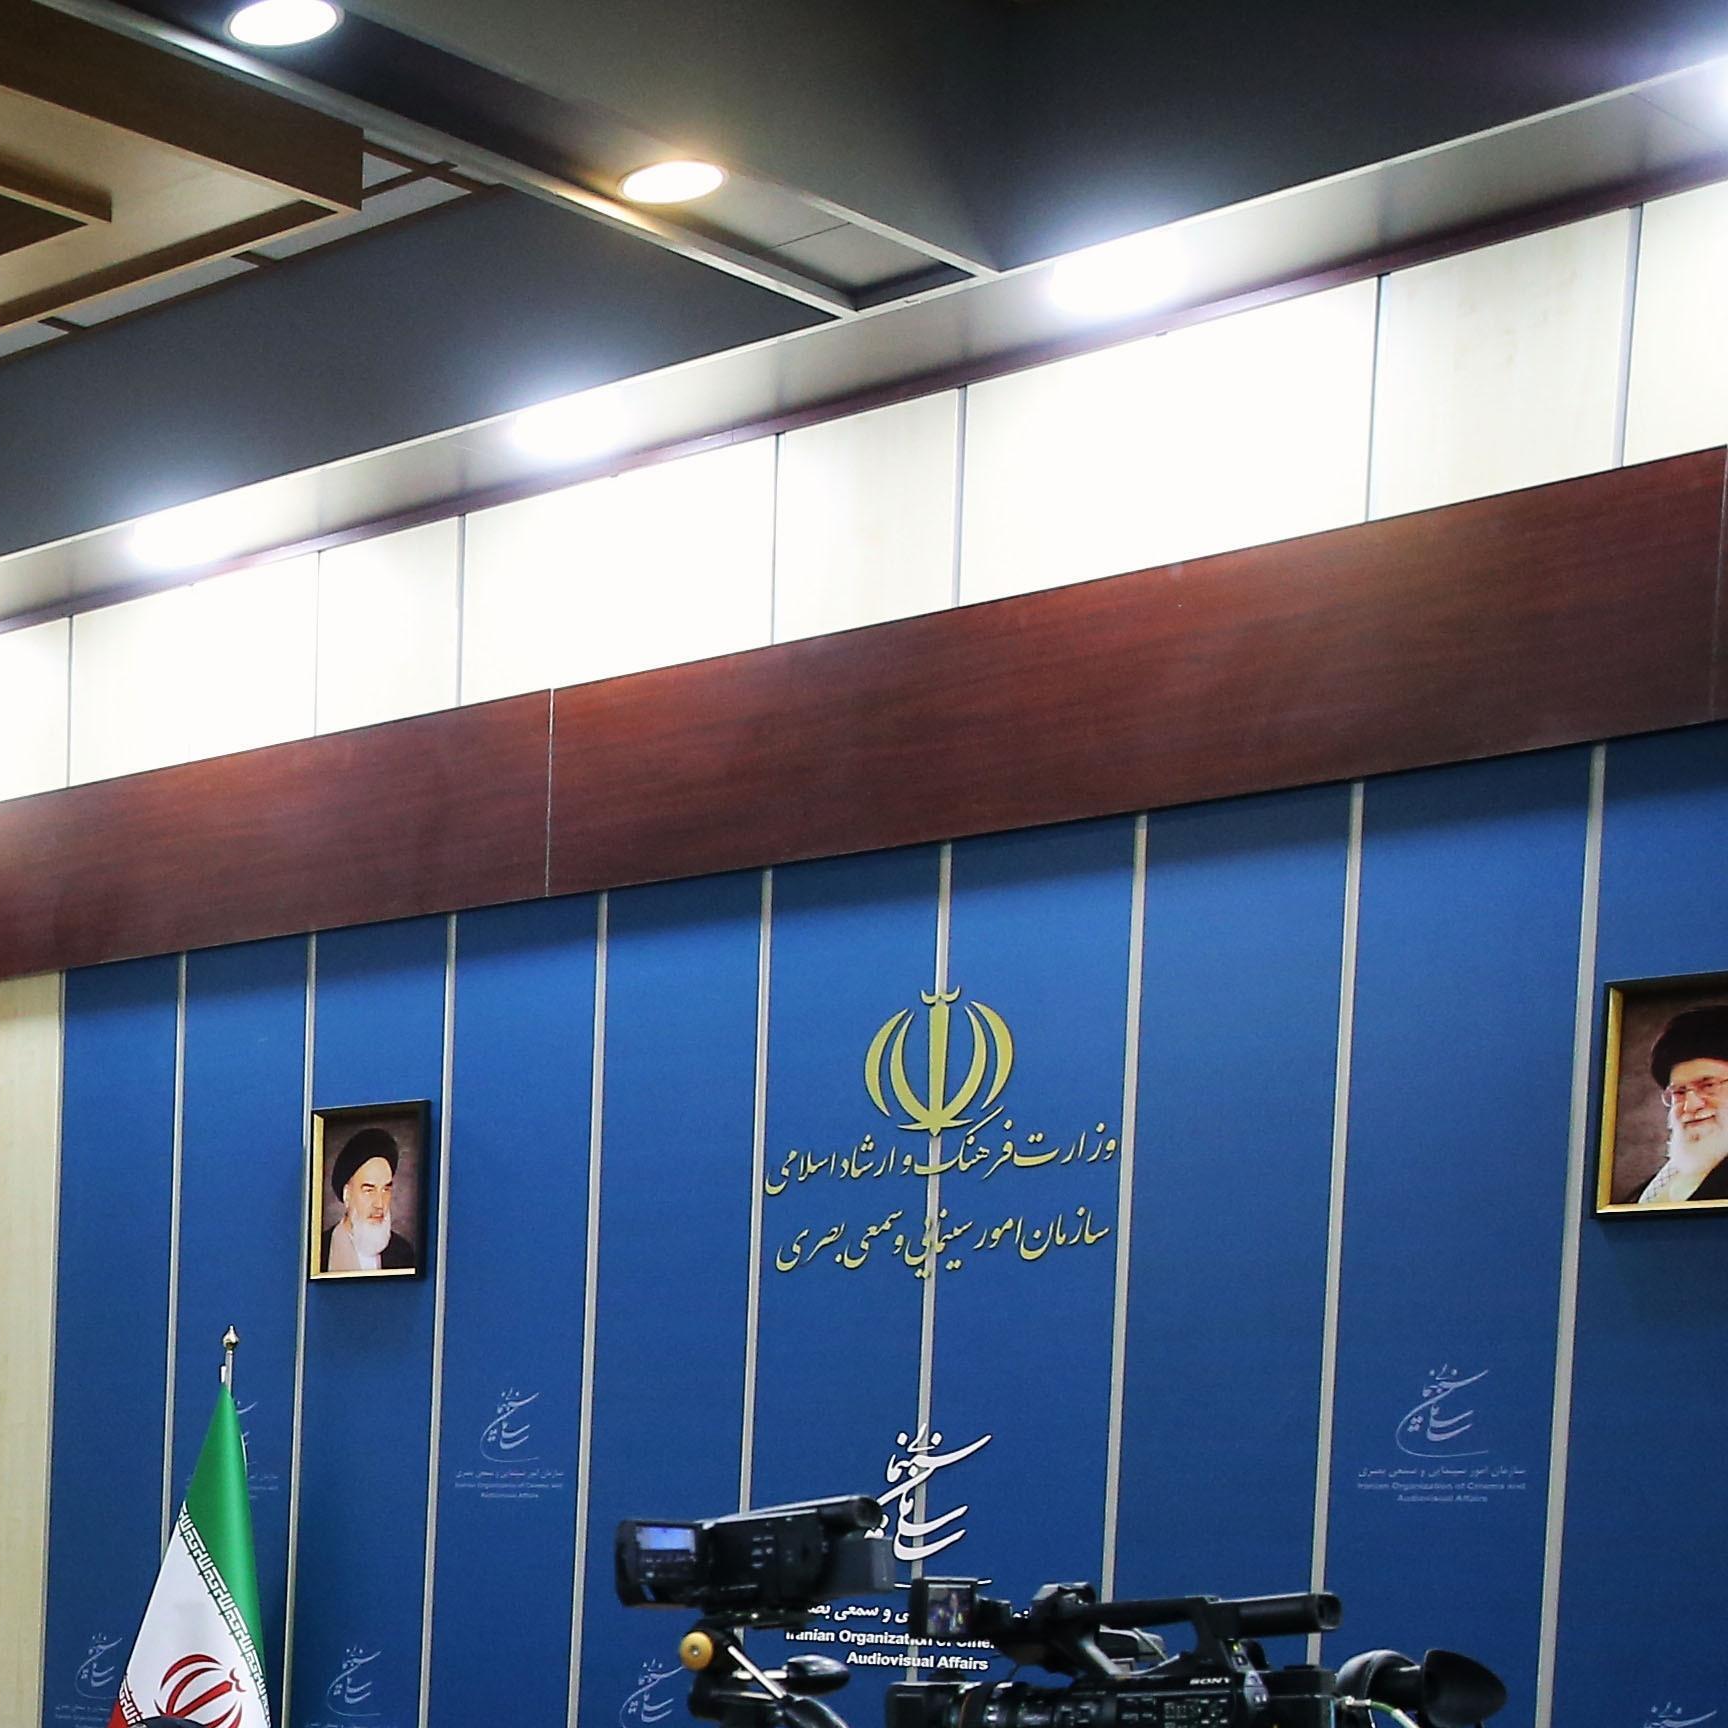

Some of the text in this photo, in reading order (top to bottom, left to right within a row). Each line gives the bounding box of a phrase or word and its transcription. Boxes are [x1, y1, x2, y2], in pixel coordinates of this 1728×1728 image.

[765, 1105, 1118, 1195] وزارت فرهنگ و ارشاد اسلامی
[776, 1206, 1110, 1279] سازمان امور سینمایی و سمعی بصری
[834, 1606, 879, 1622] سمعی
[882, 1609, 890, 1623] و
[846, 1651, 989, 1670] Audiovisual Affairs
